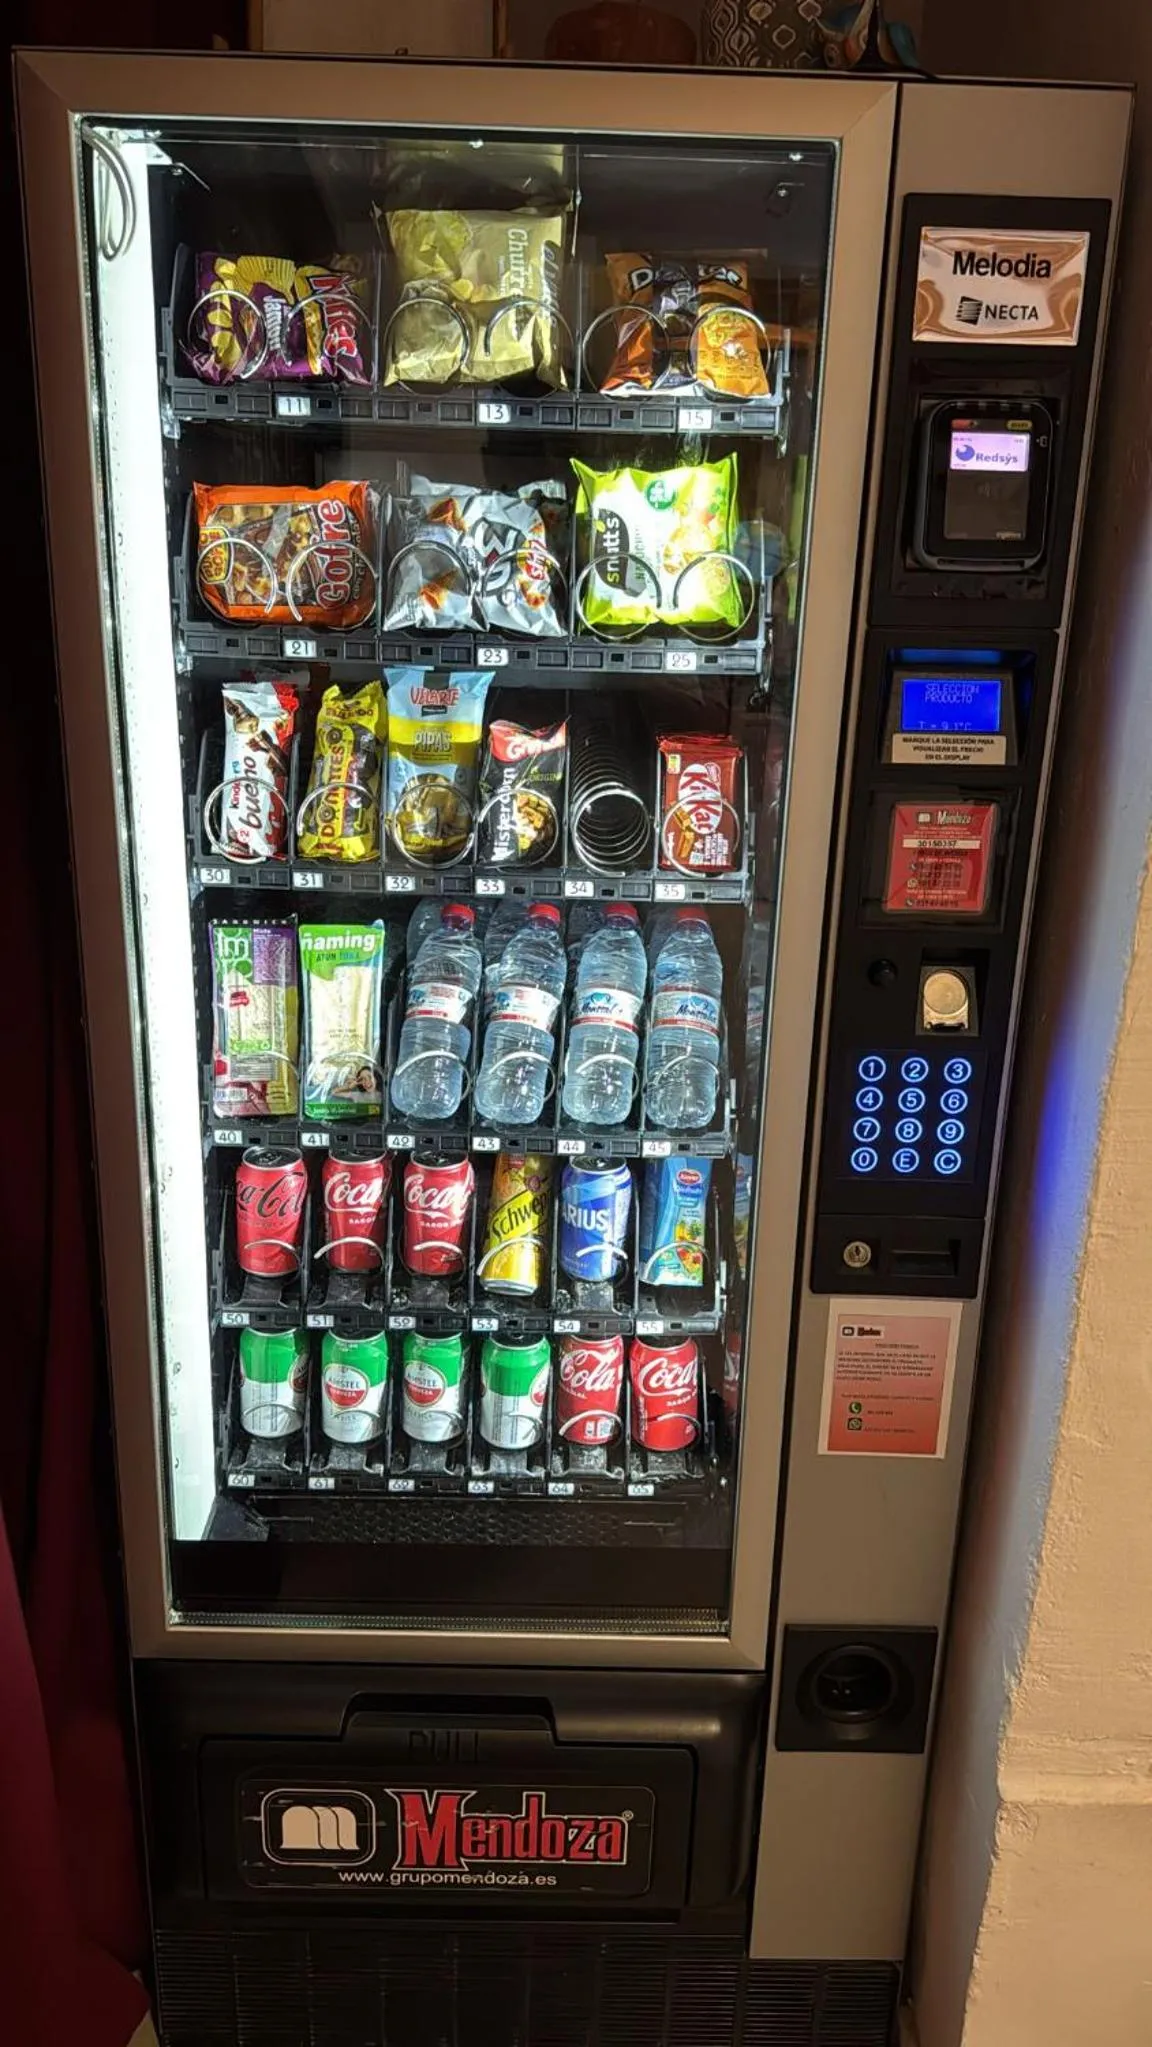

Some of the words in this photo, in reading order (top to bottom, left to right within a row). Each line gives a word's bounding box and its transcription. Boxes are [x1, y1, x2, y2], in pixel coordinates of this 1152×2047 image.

[952, 251, 1051, 278] Melodia
[985, 304, 1039, 320] NECTA
[287, 398, 304, 414] 11
[487, 405, 504, 421] 13
[686, 411, 704, 427] 15
[292, 641, 310, 655] 21
[483, 649, 503, 663] 23
[672, 654, 691, 667] 25
[415, 729, 453, 752] PIPAS
[239, 755, 263, 829] bueno
[206, 869, 224, 882] 30
[301, 874, 316, 886] 31
[391, 876, 409, 889] 32
[482, 879, 500, 892] 33
[570, 882, 587, 895] 34
[662, 884, 679, 897] 35
[301, 930, 376, 952] ñaming
[867, 1062, 876, 1077] 1
[909, 1063, 920, 1078] 2
[952, 1064, 963, 1078] 3
[862, 1092, 874, 1106] 4
[906, 1093, 917, 1108] 5
[948, 1094, 960, 1109] 6
[861, 1123, 872, 1137] 7
[902, 1123, 914, 1138] 8
[944, 1124, 956, 1139] 9
[218, 1131, 237, 1144] 40
[307, 1134, 324, 1146] 41
[392, 1136, 410, 1147] 42
[478, 1138, 495, 1149] 43
[563, 1141, 580, 1152] 44
[649, 1142, 666, 1153] 45
[858, 1152, 871, 1166] 0
[899, 1153, 912, 1168] E
[940, 1154, 954, 1169] C
[226, 1313, 244, 1325] 50
[313, 1315, 328, 1326] 51
[394, 1316, 411, 1328] 52
[476, 1319, 494, 1330] 53
[558, 1321, 575, 1332] 54
[641, 1322, 658, 1333] 55
[231, 1476, 249, 1486] 60
[315, 1478, 329, 1488] 61
[393, 1480, 410, 1490] 62
[472, 1482, 488, 1492] 63
[552, 1484, 569, 1493] 64
[632, 1485, 649, 1495] 65
[384, 1788, 629, 1871] Mendoza
[338, 1868, 557, 1888] www.grupomendoza.es
